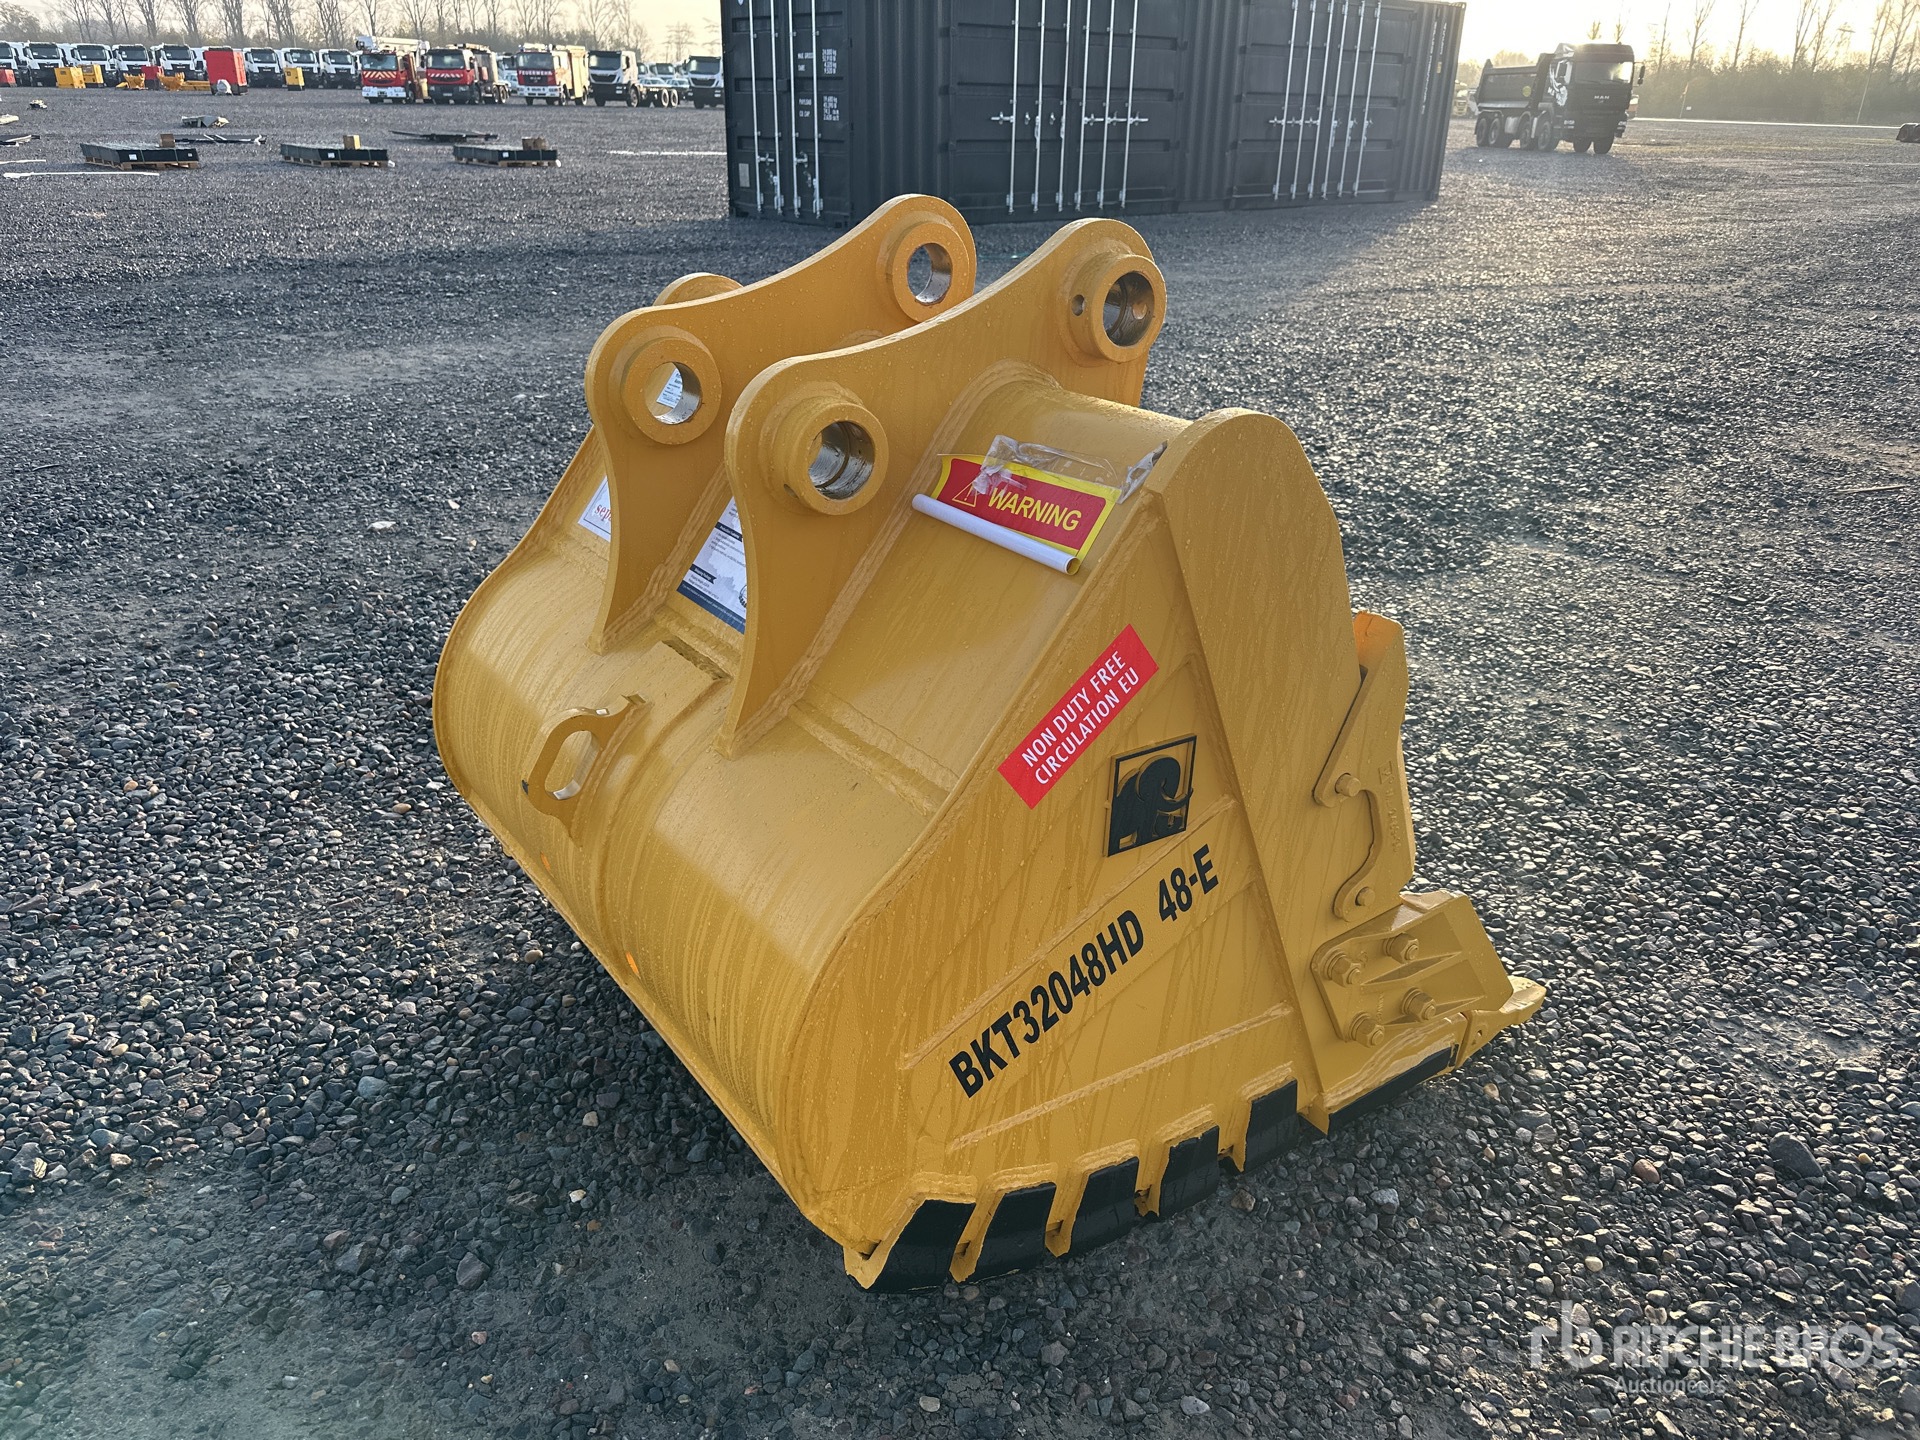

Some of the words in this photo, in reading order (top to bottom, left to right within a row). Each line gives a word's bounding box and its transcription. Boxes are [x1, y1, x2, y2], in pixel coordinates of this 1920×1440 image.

[988, 486, 1082, 531] WARNING
[1021, 727, 1057, 768] NON
[1052, 687, 1091, 734] DUTY
[1089, 650, 1126, 693] FREE
[1035, 688, 1120, 785] CIRCULATION
[1117, 666, 1139, 694] EU
[948, 910, 1144, 1099] BKT32048HD
[1157, 843, 1219, 922] 48-E
